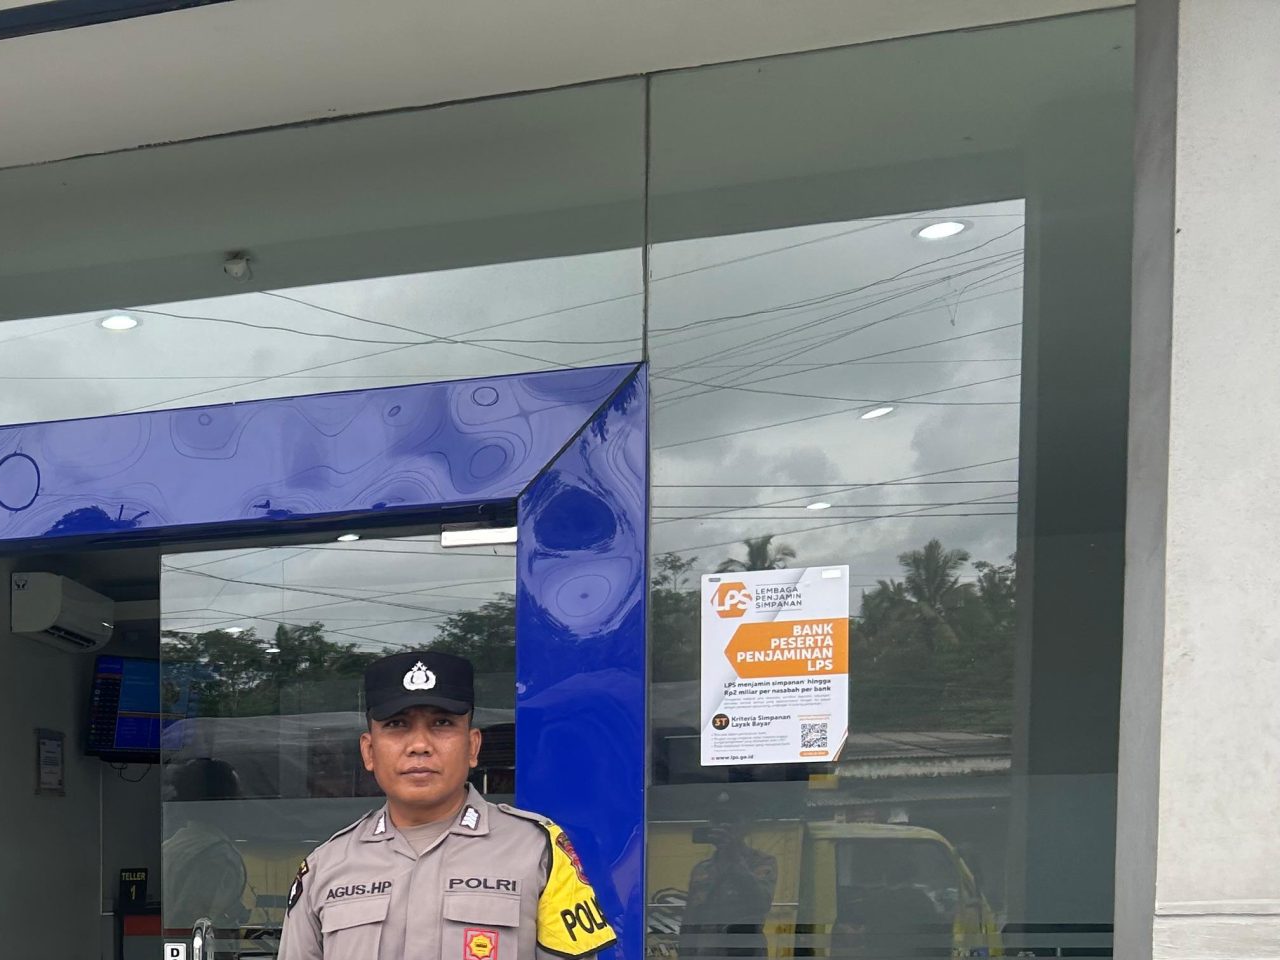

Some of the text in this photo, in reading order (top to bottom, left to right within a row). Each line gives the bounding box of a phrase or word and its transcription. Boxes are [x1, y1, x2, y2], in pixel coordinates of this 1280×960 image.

[755, 586, 799, 595] LEMBAGA
[755, 593, 802, 602] PENJAMIN
[792, 623, 833, 636] BANK
[770, 635, 833, 649] PESERTA
[736, 647, 833, 663] PENJAMINAN
[807, 660, 833, 671] LPS
[737, 681, 770, 689] menjamin
[724, 689, 737, 697] Rp2
[714, 717, 728, 727] 3T
[758, 714, 791, 722] Simpanan
[752, 720, 771, 728] Bayar
[121, 872, 146, 881] TELLER
[448, 877, 517, 892] POLRI
[326, 880, 392, 900] AGUS.HP
